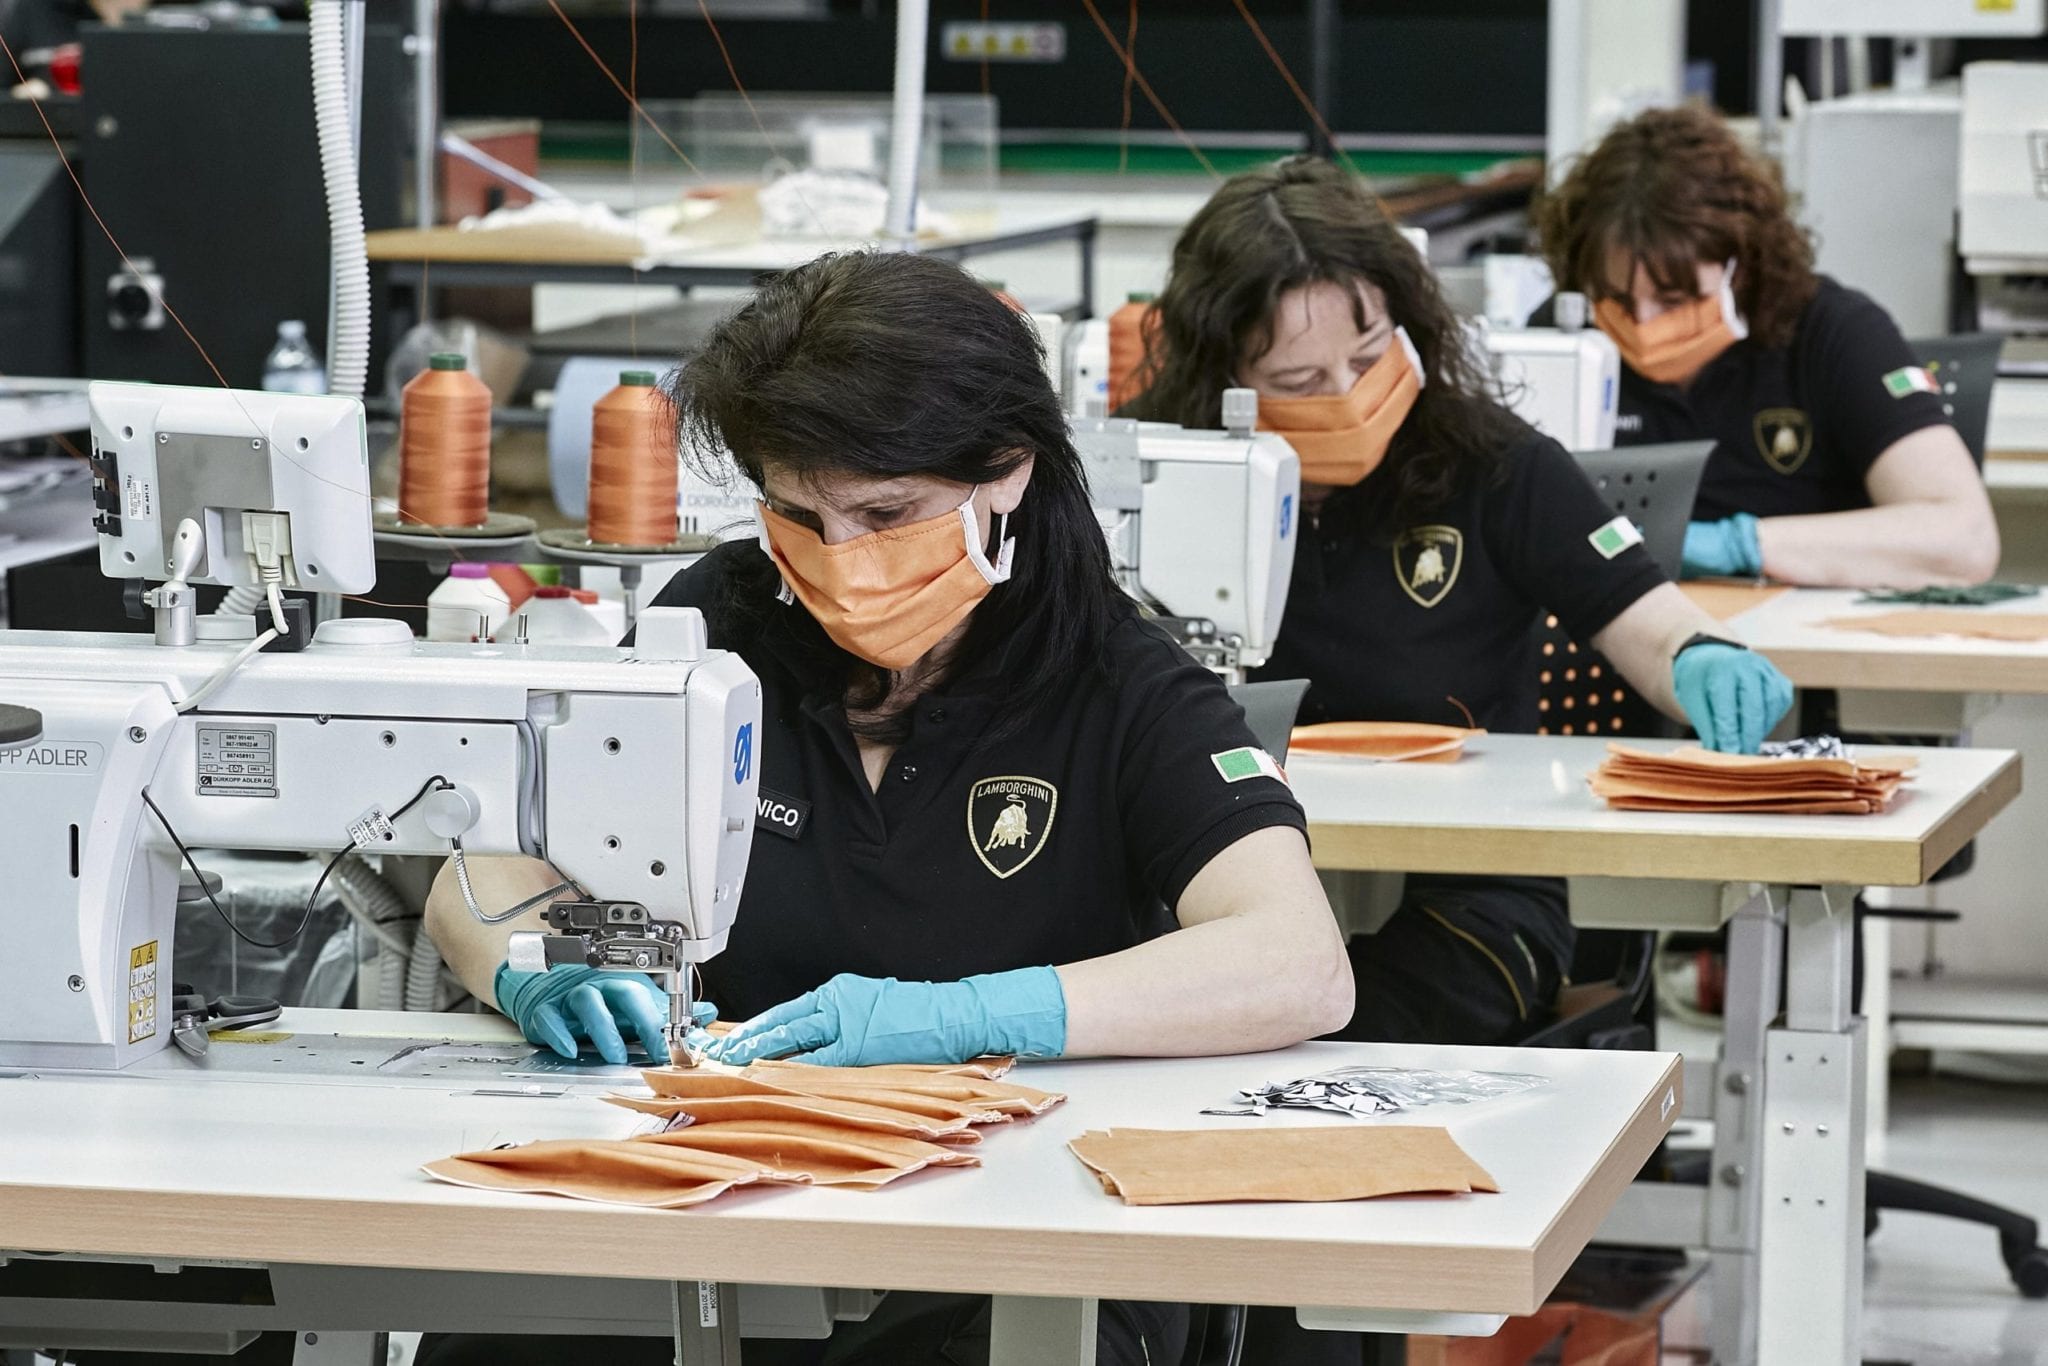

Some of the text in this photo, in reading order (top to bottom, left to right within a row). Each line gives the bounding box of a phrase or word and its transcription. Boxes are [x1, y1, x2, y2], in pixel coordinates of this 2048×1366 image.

[26, 748, 88, 766] ADLER
[977, 781, 1050, 803] LAMBORGHINI
[756, 796, 799, 827] NICO
